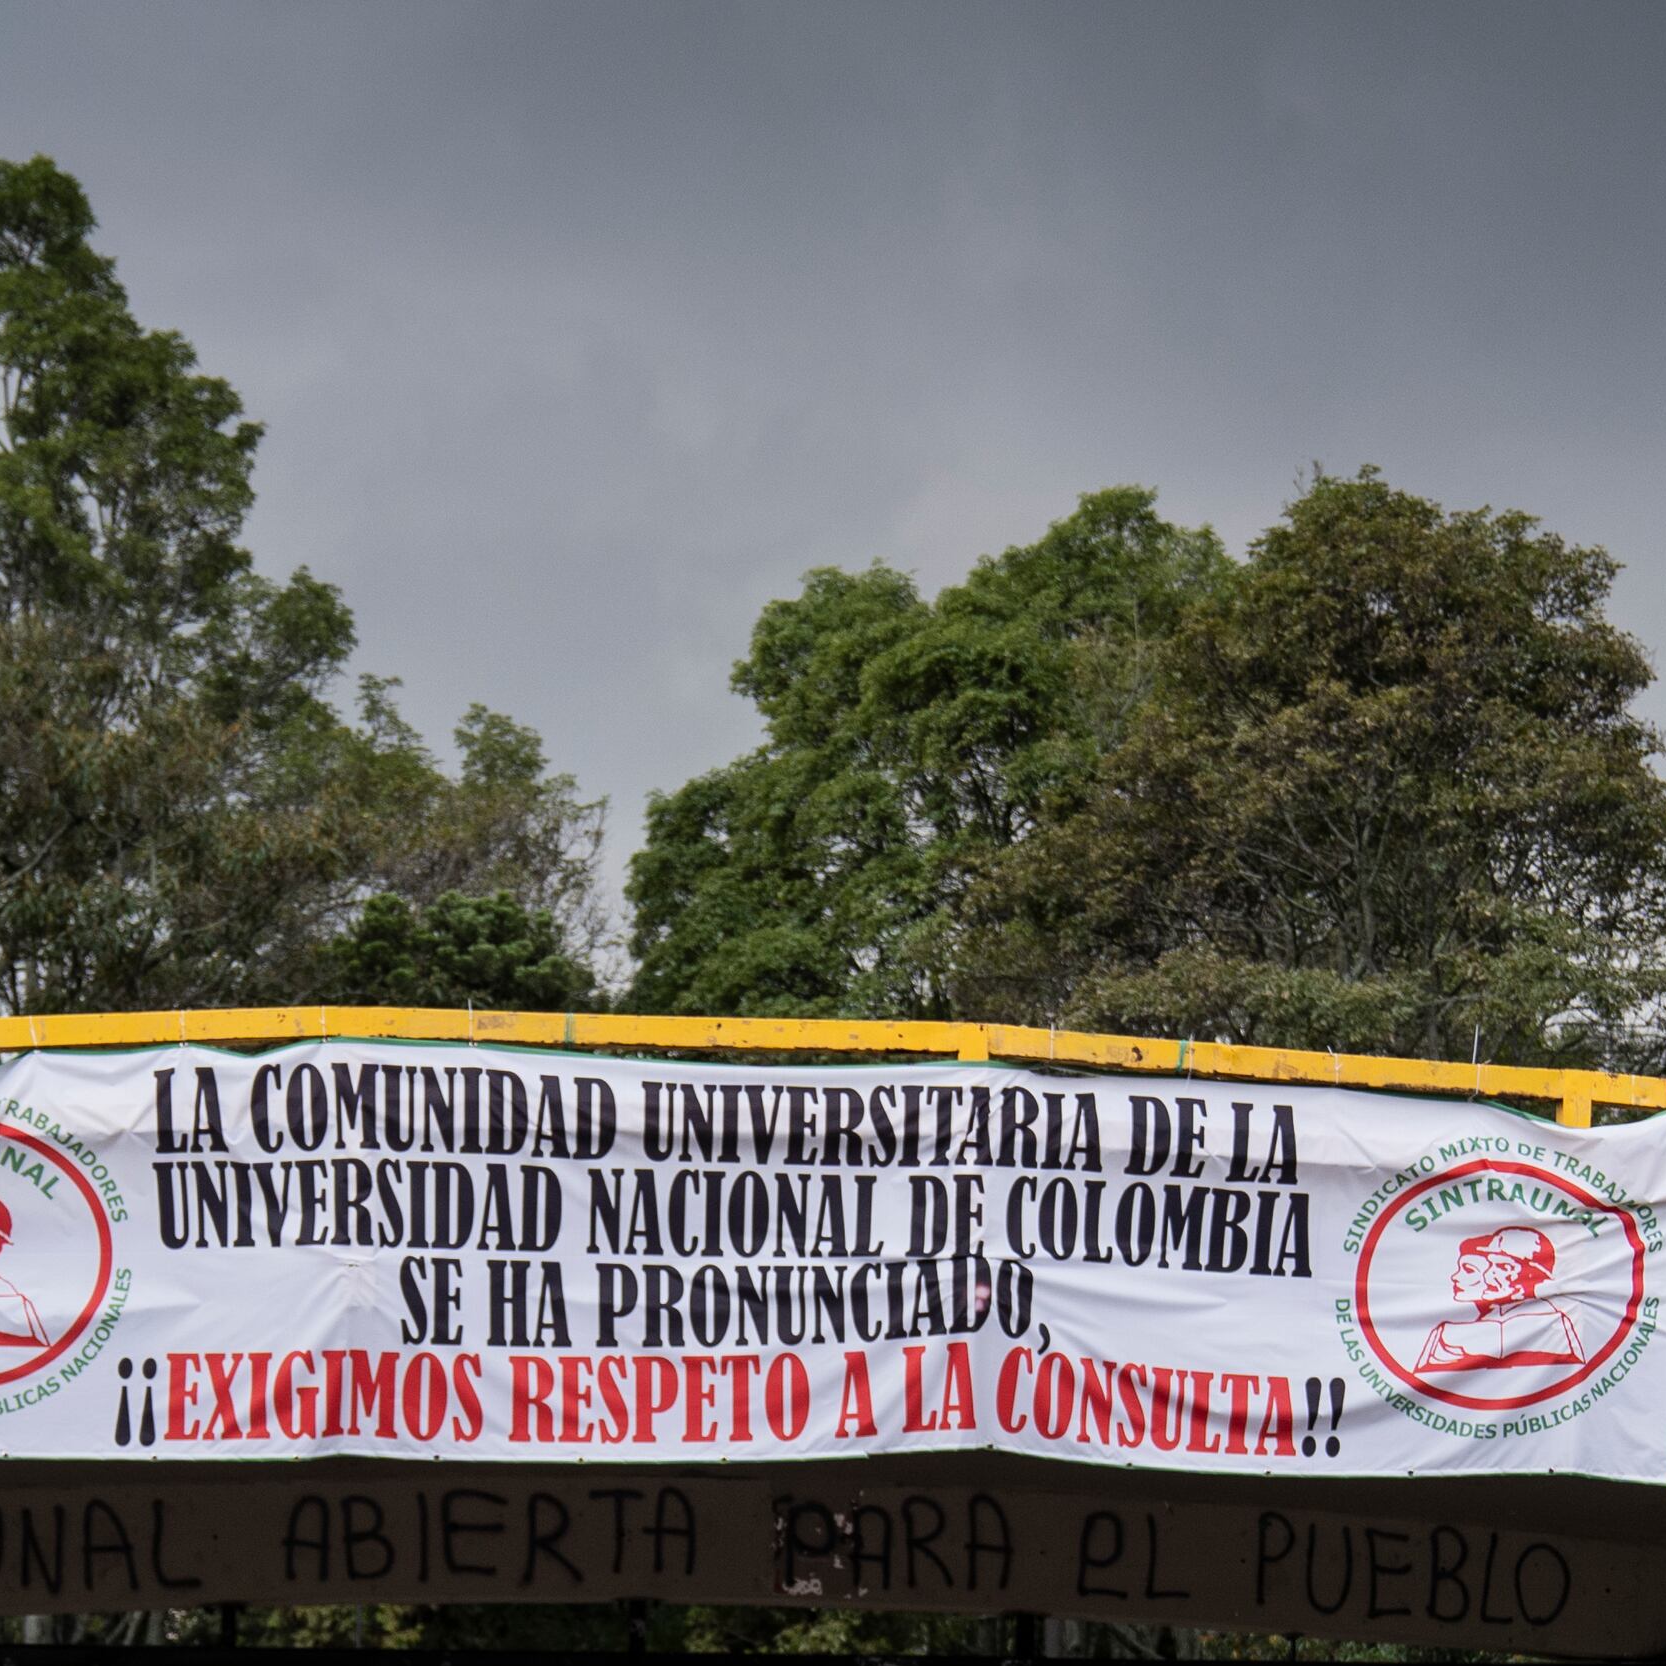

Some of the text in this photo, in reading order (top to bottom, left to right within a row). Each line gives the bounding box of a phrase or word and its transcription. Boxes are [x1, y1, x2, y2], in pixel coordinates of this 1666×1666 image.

[154, 1062, 1298, 1185] LA COMUNIDAD UNIVERSITARIA DE LA
[153, 1158, 1312, 1278] UNIVERSIDAD NACIONAL DE COLOMBIA
[1342, 1155, 1437, 1256] SINDICATO
[1438, 1135, 1510, 1163] MIXTO
[1517, 1142, 1547, 1162] DE
[1404, 1176, 1611, 1239] SINTRAUNAL
[61, 1267, 133, 1386] NACIONALES
[400, 1256, 1051, 1355] SE HA PRONUNCIADO,
[115, 1342, 1347, 1458] ¡¡EXIGIMOS RESPETO A LA CONSULTA!!
[1335, 1295, 1661, 1440] DE LAS UNIVERSIDADES PÚBLICAS NACIONALES
[281, 1489, 696, 1585] ABIERTA
[779, 1490, 1015, 1595] PARA
[1256, 1510, 1572, 1627] PUEBLO
